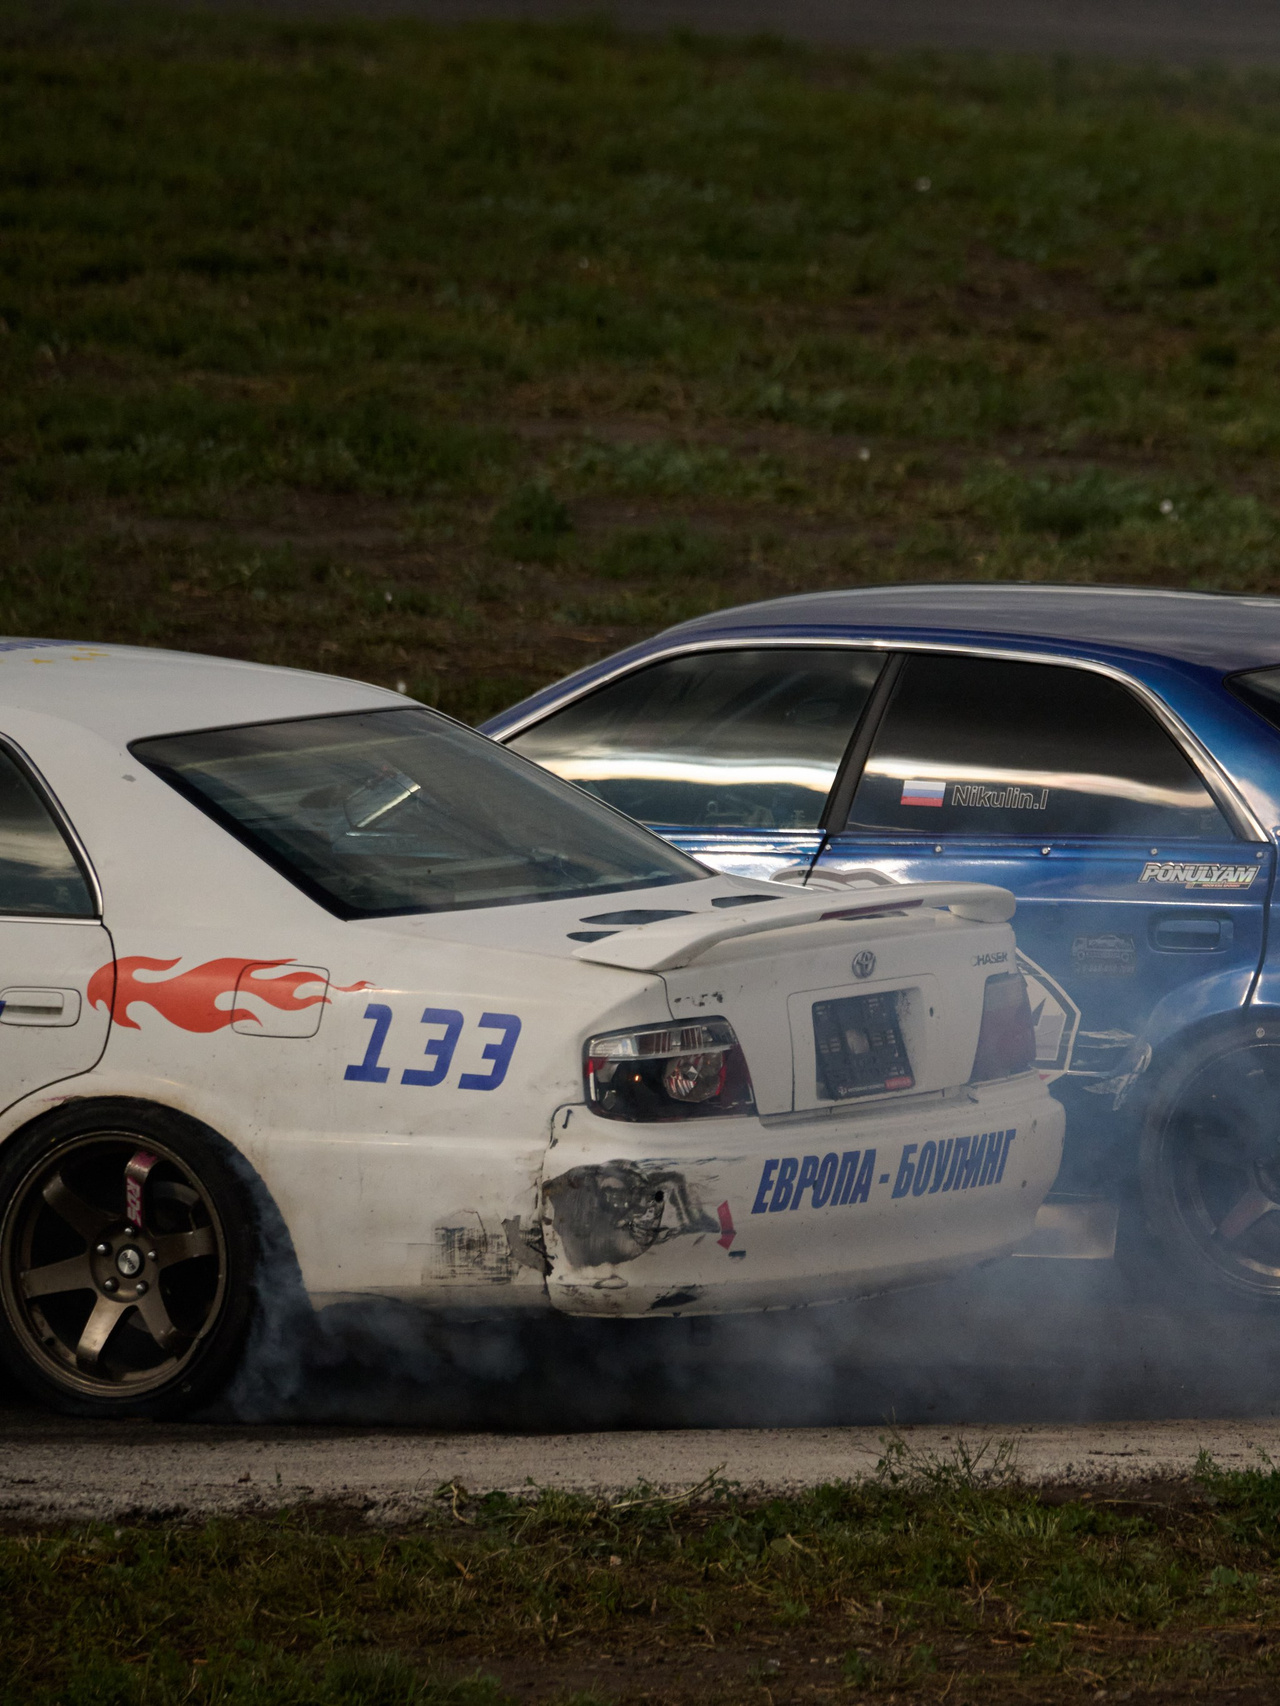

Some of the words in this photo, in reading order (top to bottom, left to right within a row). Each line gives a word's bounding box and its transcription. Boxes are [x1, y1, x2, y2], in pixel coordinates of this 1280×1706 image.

[1139, 863, 1259, 883] PONULYAM
[343, 1003, 522, 1091] 133
[751, 1148, 877, 1215] ЕВРОПА
[891, 1128, 1017, 1200] БОУЛИНГ
